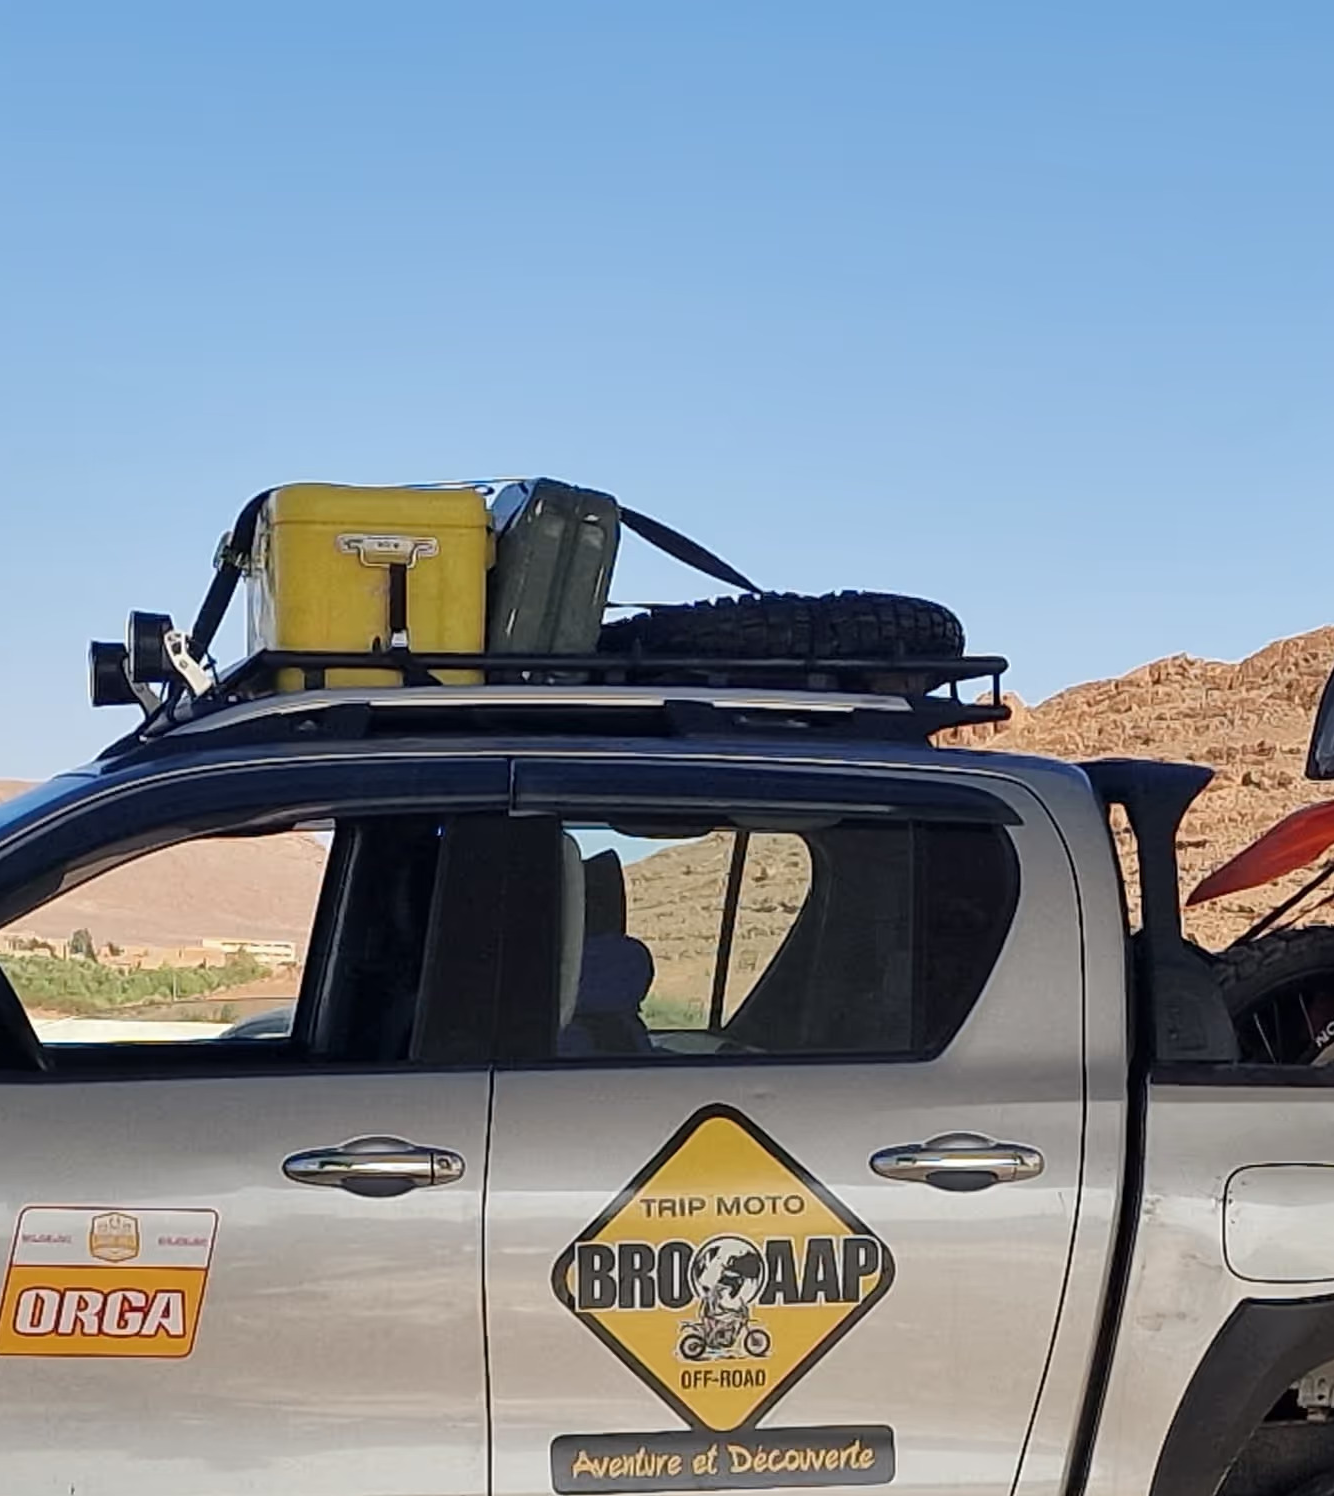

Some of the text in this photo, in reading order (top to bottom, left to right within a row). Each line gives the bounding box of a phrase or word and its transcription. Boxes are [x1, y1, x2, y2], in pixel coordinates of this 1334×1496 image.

[640, 1194, 805, 1219] TRIP MOTO
[12, 1287, 188, 1338] ORGA
[680, 1369, 766, 1390] OFF-ROAD
[572, 1439, 877, 1481] Aventure et Découverte
